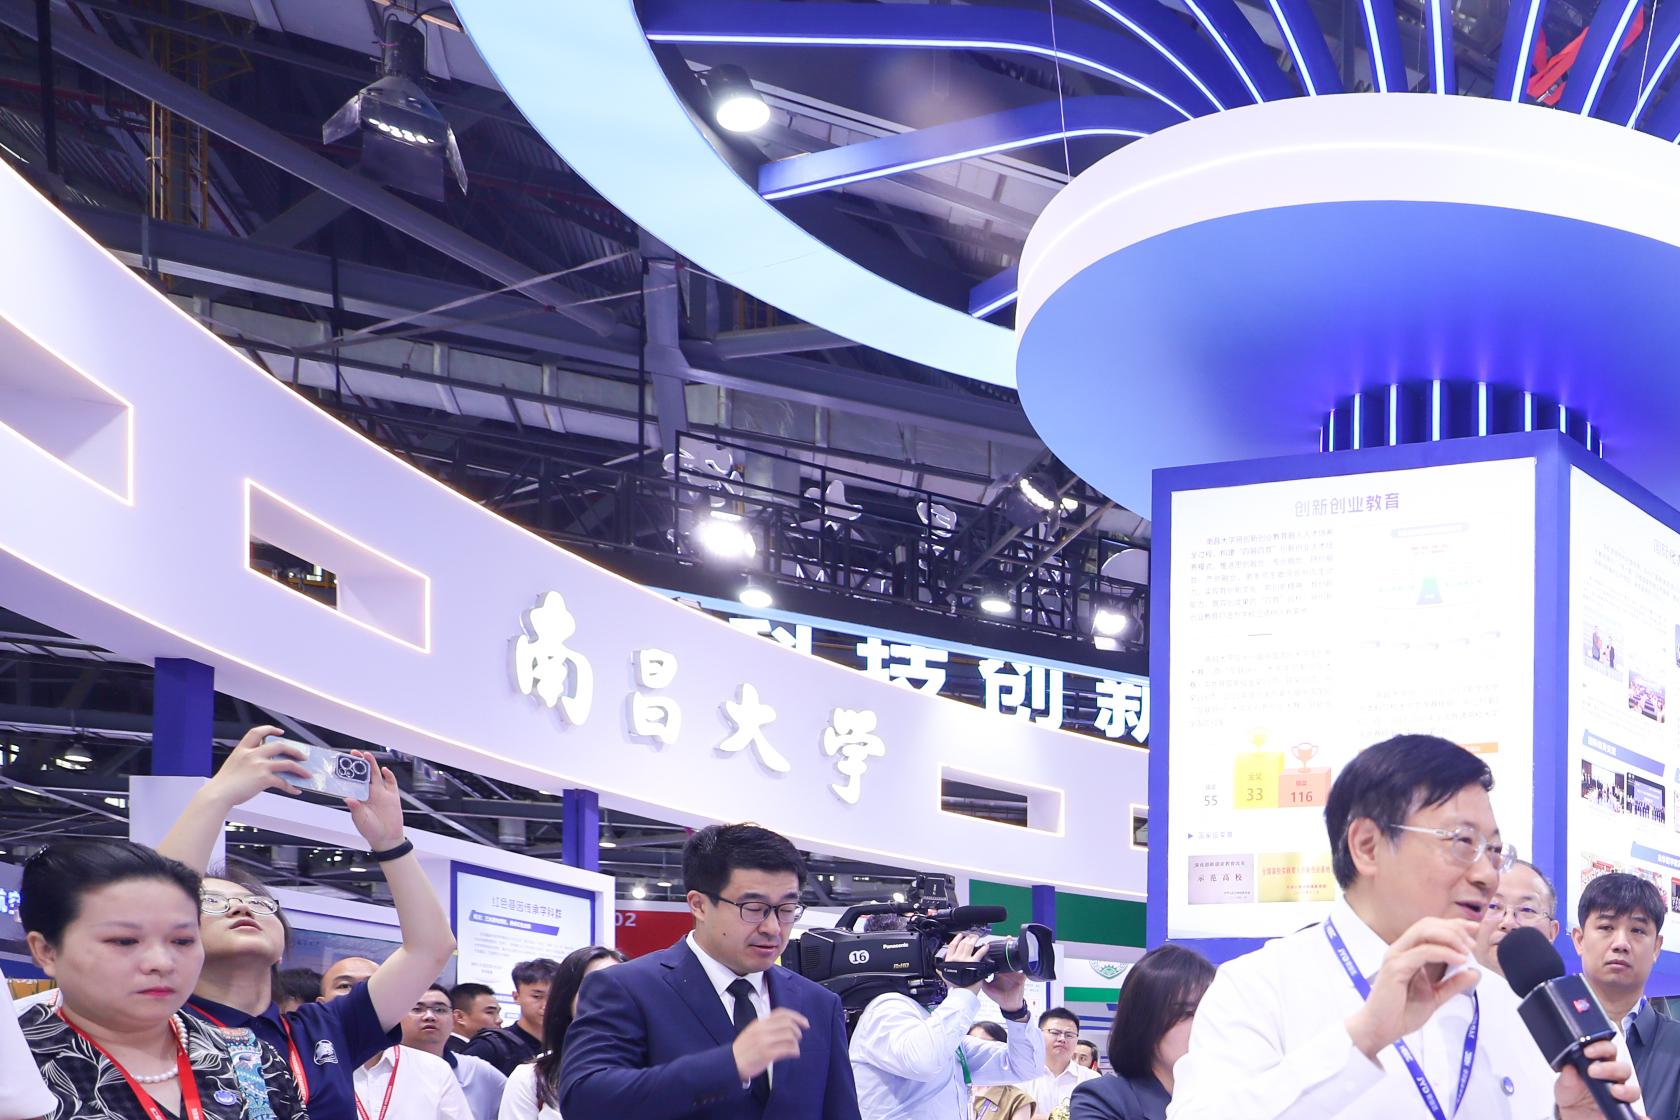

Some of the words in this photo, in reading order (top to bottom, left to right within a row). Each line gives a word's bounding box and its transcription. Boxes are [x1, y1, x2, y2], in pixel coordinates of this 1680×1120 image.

[1293, 492, 1402, 518] 创新创业教育
[510, 589, 887, 805] 南昌大学
[1203, 794, 1219, 807] 55
[1245, 787, 1264, 802] 33
[1290, 790, 1313, 803] 116
[1197, 873, 1244, 883] 示范高校
[882, 942, 909, 950] Panasonic
[850, 950, 868, 963] 16
